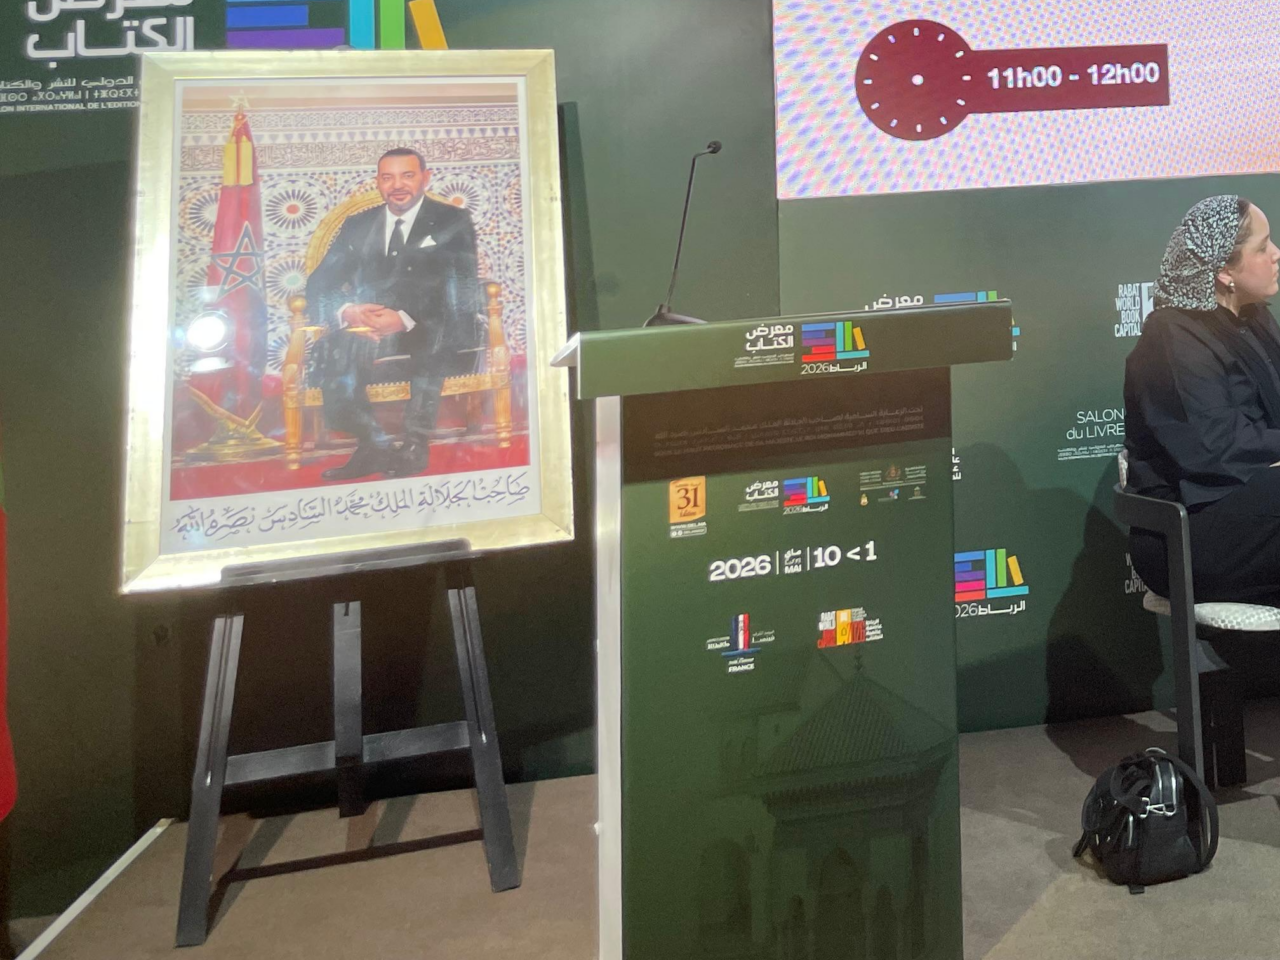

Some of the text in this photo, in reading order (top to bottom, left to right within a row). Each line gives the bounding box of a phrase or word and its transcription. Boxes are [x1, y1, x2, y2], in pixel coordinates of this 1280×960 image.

[27, 17, 194, 68] الكتاب
[988, 65, 1062, 89] 11h00
[1087, 62, 1160, 86] 12h00
[17, 102, 86, 112] INTERNATIONAL
[1118, 283, 1140, 297] RABAT
[1115, 297, 1140, 311] WORLD
[1121, 310, 1141, 323] BOOK
[746, 324, 794, 339] معرض
[1115, 322, 1142, 337] CAPITAL
[746, 336, 794, 353] الكتاب
[1077, 408, 1124, 424] SALON
[1066, 423, 1125, 440] du LIVRE
[677, 487, 700, 510] 31
[813, 540, 877, 568] 10 1
[709, 554, 772, 581] 2026
[784, 564, 802, 574] MAI
[728, 663, 755, 673] FRANCE
